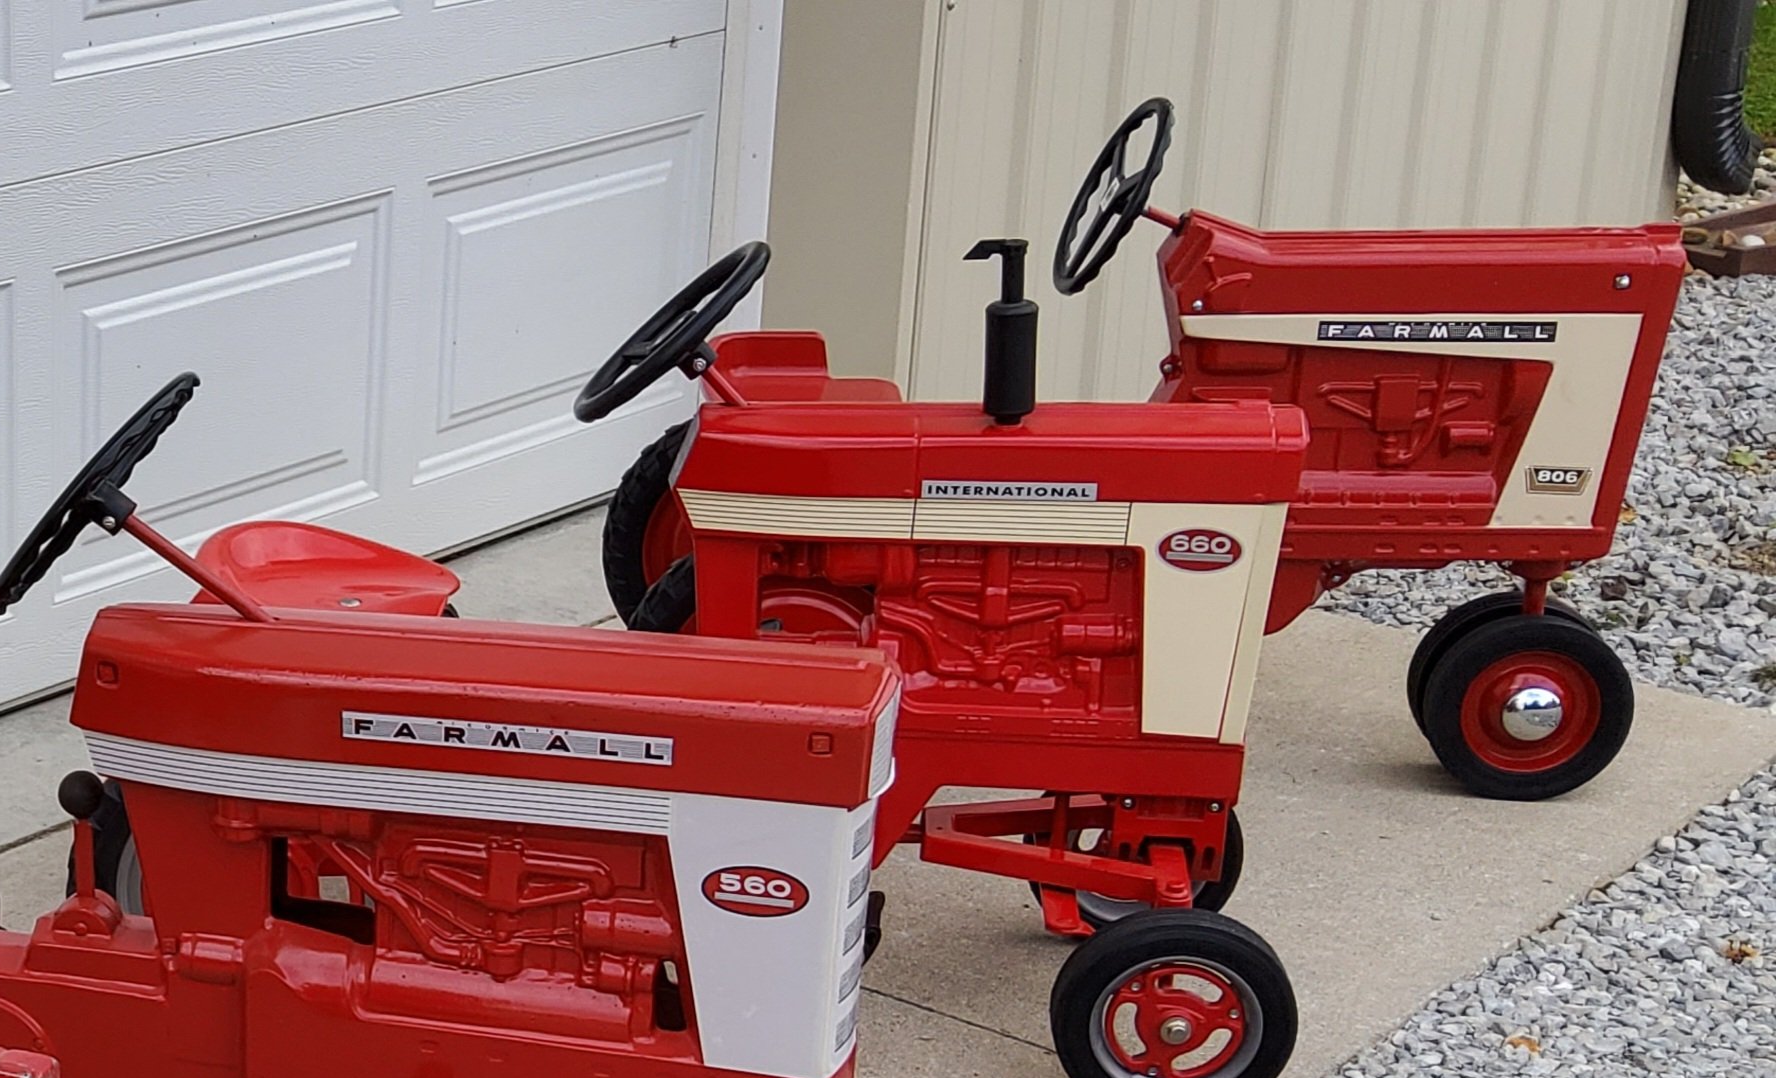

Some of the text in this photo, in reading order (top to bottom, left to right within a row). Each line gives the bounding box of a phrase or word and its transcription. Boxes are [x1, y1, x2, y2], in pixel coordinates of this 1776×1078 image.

[1327, 324, 1550, 339] FARMALL
[1537, 470, 1579, 483] 806
[926, 484, 1091, 498] INTERNATIONAL
[1170, 534, 1232, 554] 660
[353, 718, 665, 761] FARMALL
[719, 872, 792, 898] 560
